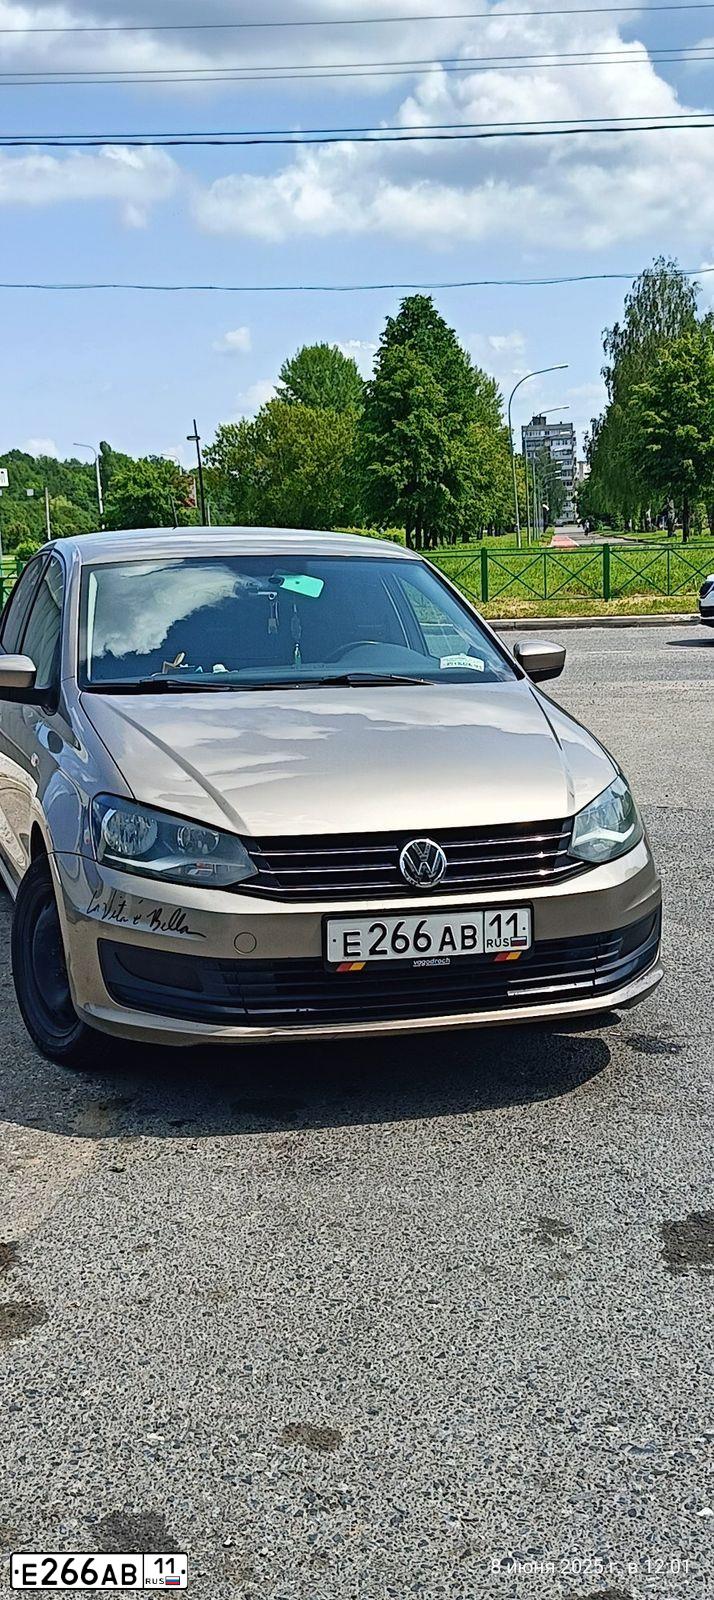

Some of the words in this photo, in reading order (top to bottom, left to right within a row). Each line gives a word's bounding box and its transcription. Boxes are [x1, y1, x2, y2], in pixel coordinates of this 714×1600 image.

[147, 907, 207, 938] Bella
[488, 912, 519, 939] 11
[486, 938, 510, 948] RUS
